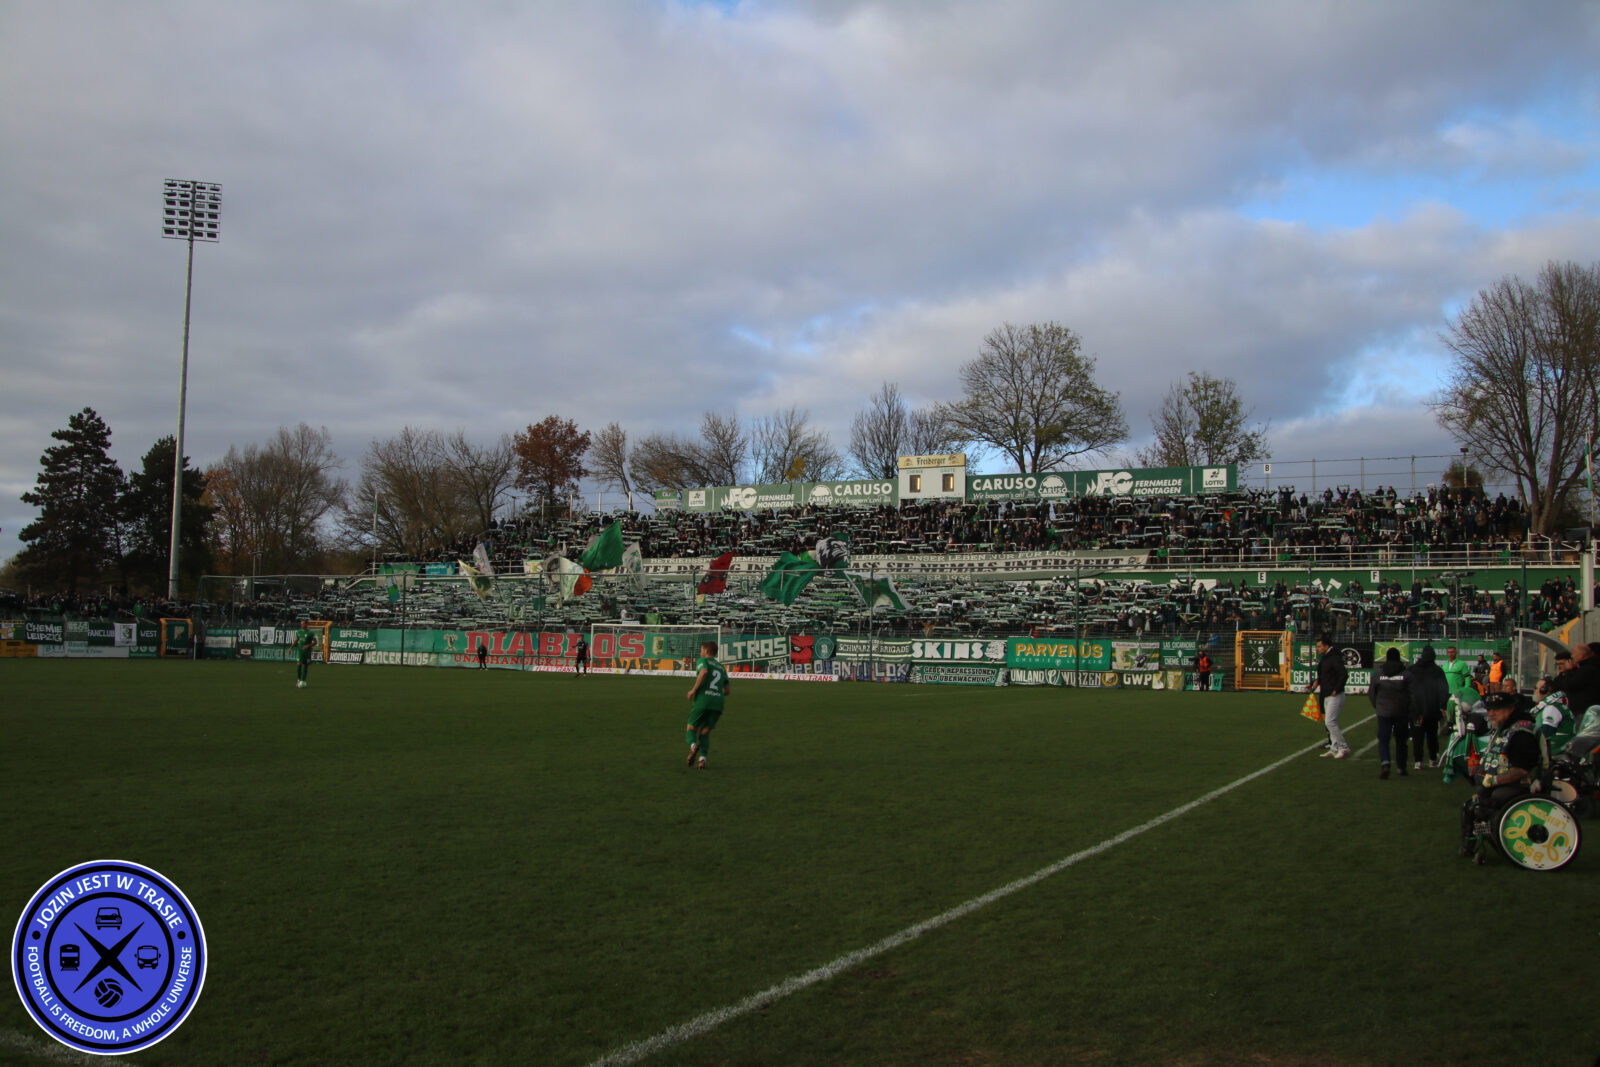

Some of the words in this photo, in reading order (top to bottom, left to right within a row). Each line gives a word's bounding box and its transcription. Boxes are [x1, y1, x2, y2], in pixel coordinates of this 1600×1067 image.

[973, 477, 1037, 490] CARUSO
[1135, 479, 1183, 488] FERNMELDE
[834, 483, 893, 496] CARUSO
[1133, 487, 1181, 495] MONTAGEN
[758, 494, 795, 502] FERNMELDE
[1259, 572, 1265, 581] E
[1372, 571, 1378, 580] F
[26, 622, 63, 633] CHEMIE
[27, 632, 63, 642] LEIPZIG
[140, 630, 158, 638] WEST
[238, 629, 260, 643] SPORTS
[331, 640, 377, 650] BASTARDS
[464, 631, 645, 659] DIABLOS
[880, 644, 910, 654] BRIGADE
[911, 641, 984, 659] SKINS
[1015, 642, 1104, 659] PARVENÜS
[330, 652, 364, 662] KOMBINAT
[1164, 657, 1180, 666] CHEMIE
[924, 666, 946, 674] GEGEN
[946, 667, 996, 676] REPRESSIONEN
[709, 670, 722, 691] 2
[924, 674, 938, 682] UND
[1010, 670, 1045, 685] UMLAND
[1122, 672, 1153, 686] GWP
